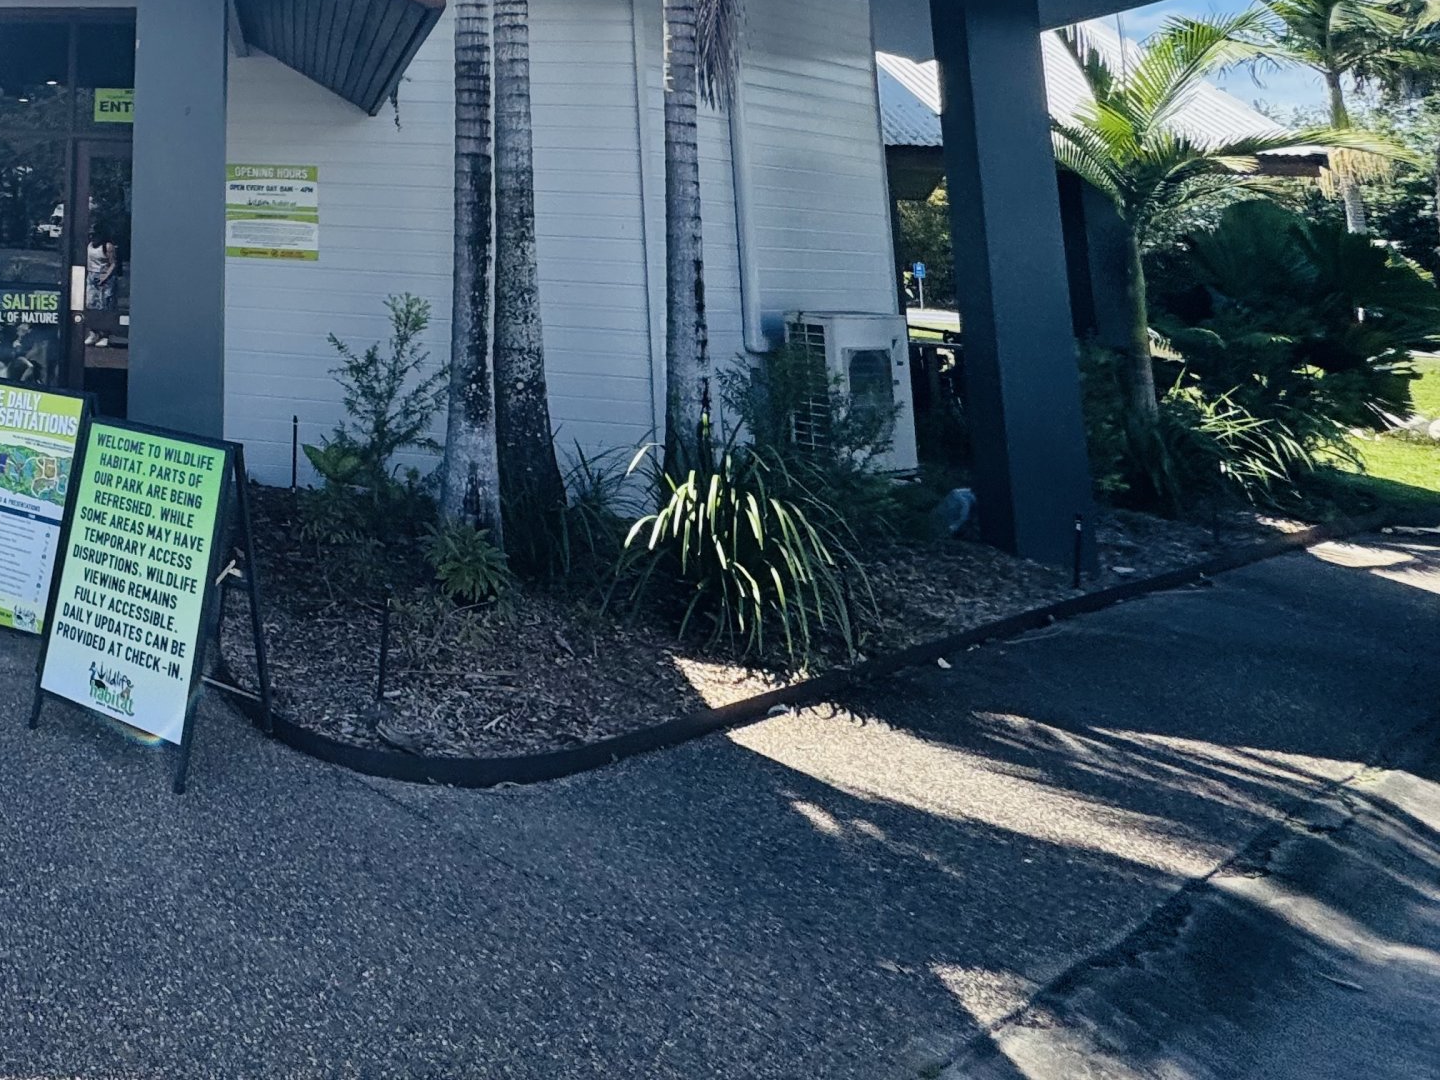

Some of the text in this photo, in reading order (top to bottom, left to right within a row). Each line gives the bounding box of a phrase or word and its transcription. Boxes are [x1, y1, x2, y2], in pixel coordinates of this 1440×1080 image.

[99, 101, 135, 113] ENT
[234, 166, 308, 180] OPENING HOURS
[246, 184, 264, 192] EVERY
[2, 293, 58, 311] SALTIES
[7, 311, 20, 322] OF
[22, 311, 58, 324] NATURE
[7, 391, 41, 411] DAILY
[97, 433, 145, 455] WELCOME
[148, 443, 161, 458] TO
[164, 447, 215, 471] WILDLIFE
[100, 452, 203, 488] HABITAT. PARTS OF
[94, 471, 203, 509] OUR PARK ARE BEING
[94, 490, 194, 528] REFRESHED. WHILE
[80, 506, 204, 552] SOME AREAS MAY HAVE
[84, 526, 193, 570] TEMPORARY ACCESS
[84, 567, 178, 610] VIEWING REMAINS
[146, 565, 198, 594] WILDLIFE
[74, 585, 178, 633] FULLY ACCESSIBLE.
[62, 602, 93, 625] DAILY
[94, 613, 143, 643] UPDATES
[145, 631, 168, 652] CAN
[170, 639, 186, 658] BE
[56, 621, 183, 681] PROVIDED AT CHECK-IN.
